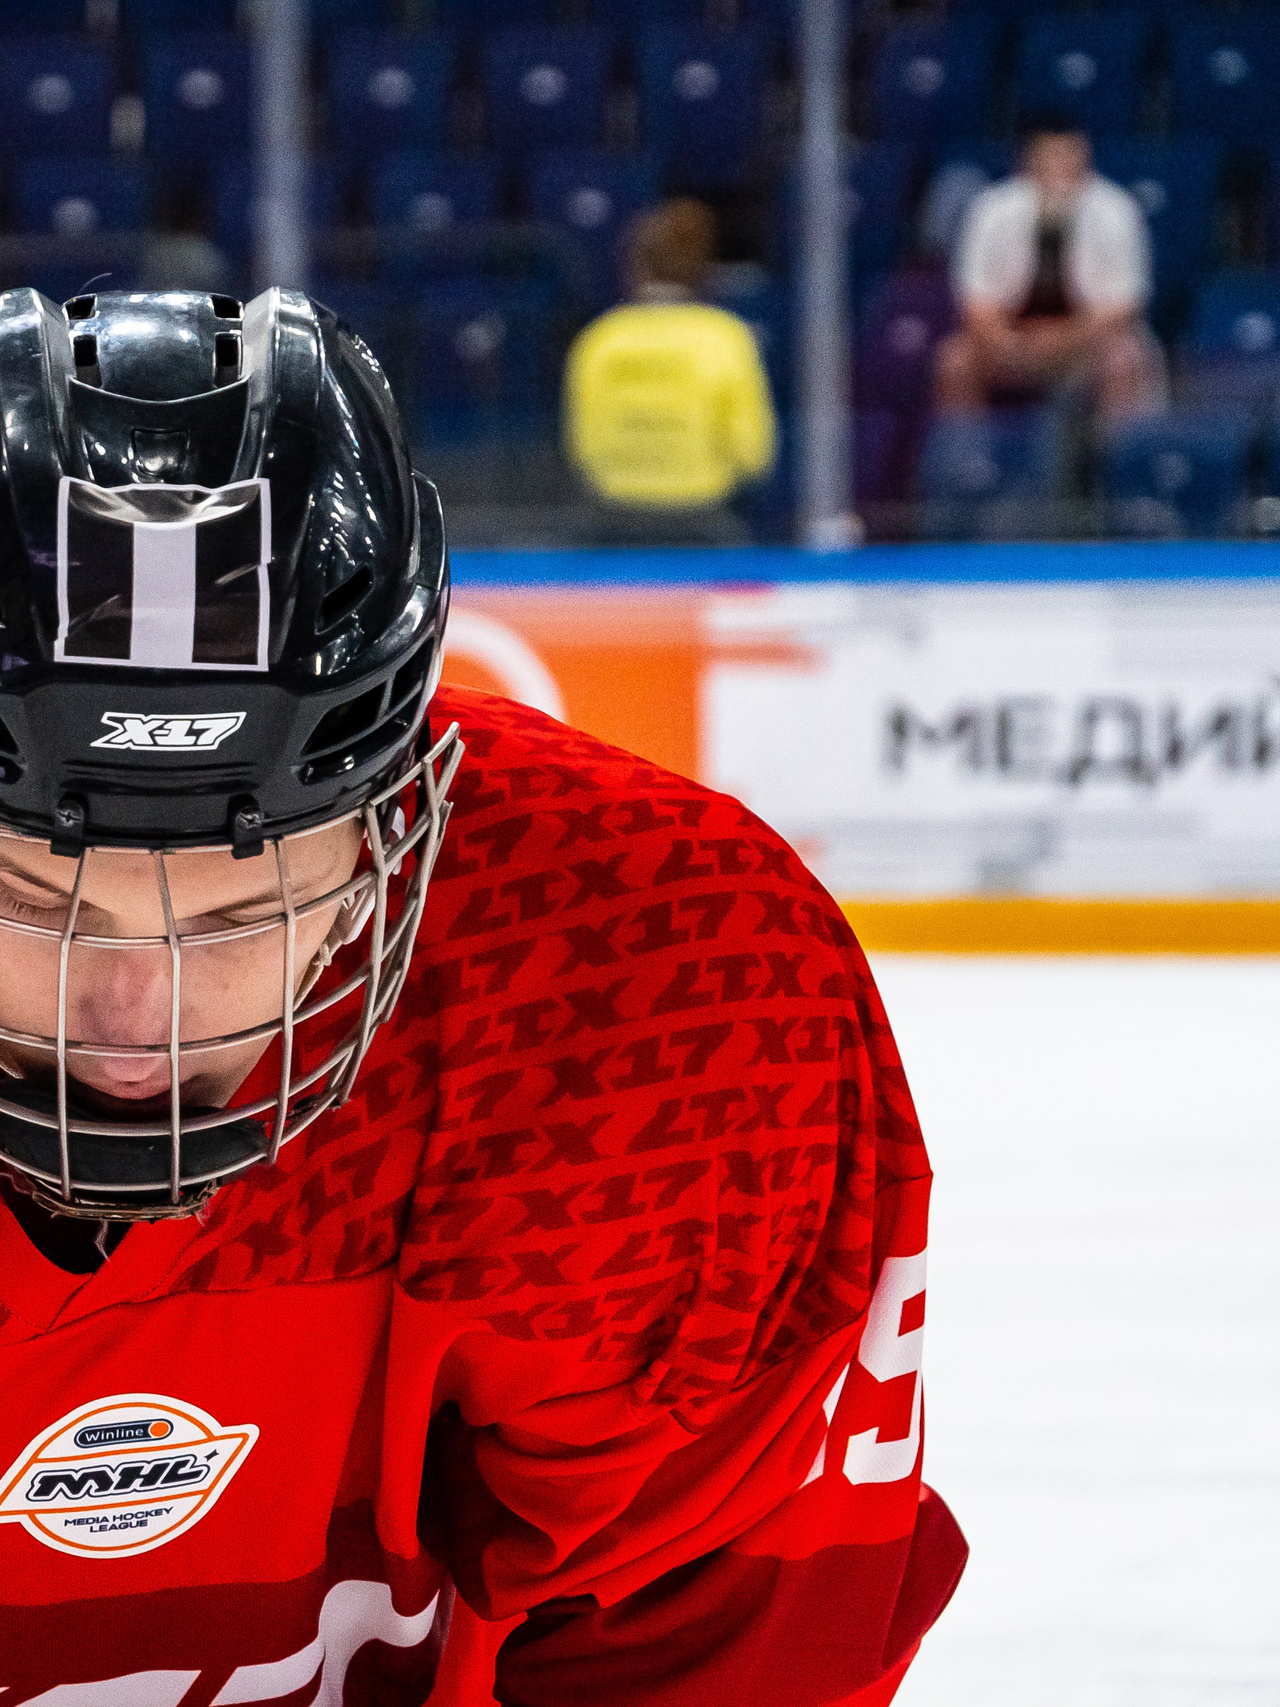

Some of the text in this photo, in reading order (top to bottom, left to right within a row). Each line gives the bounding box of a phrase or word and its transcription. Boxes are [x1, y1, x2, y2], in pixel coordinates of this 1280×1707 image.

[85, 1425, 144, 1442] Winline
[26, 1454, 210, 1502] MHL
[64, 1506, 173, 1527] MEDIA HOCKEY
[89, 1519, 148, 1533] LEAGUE
